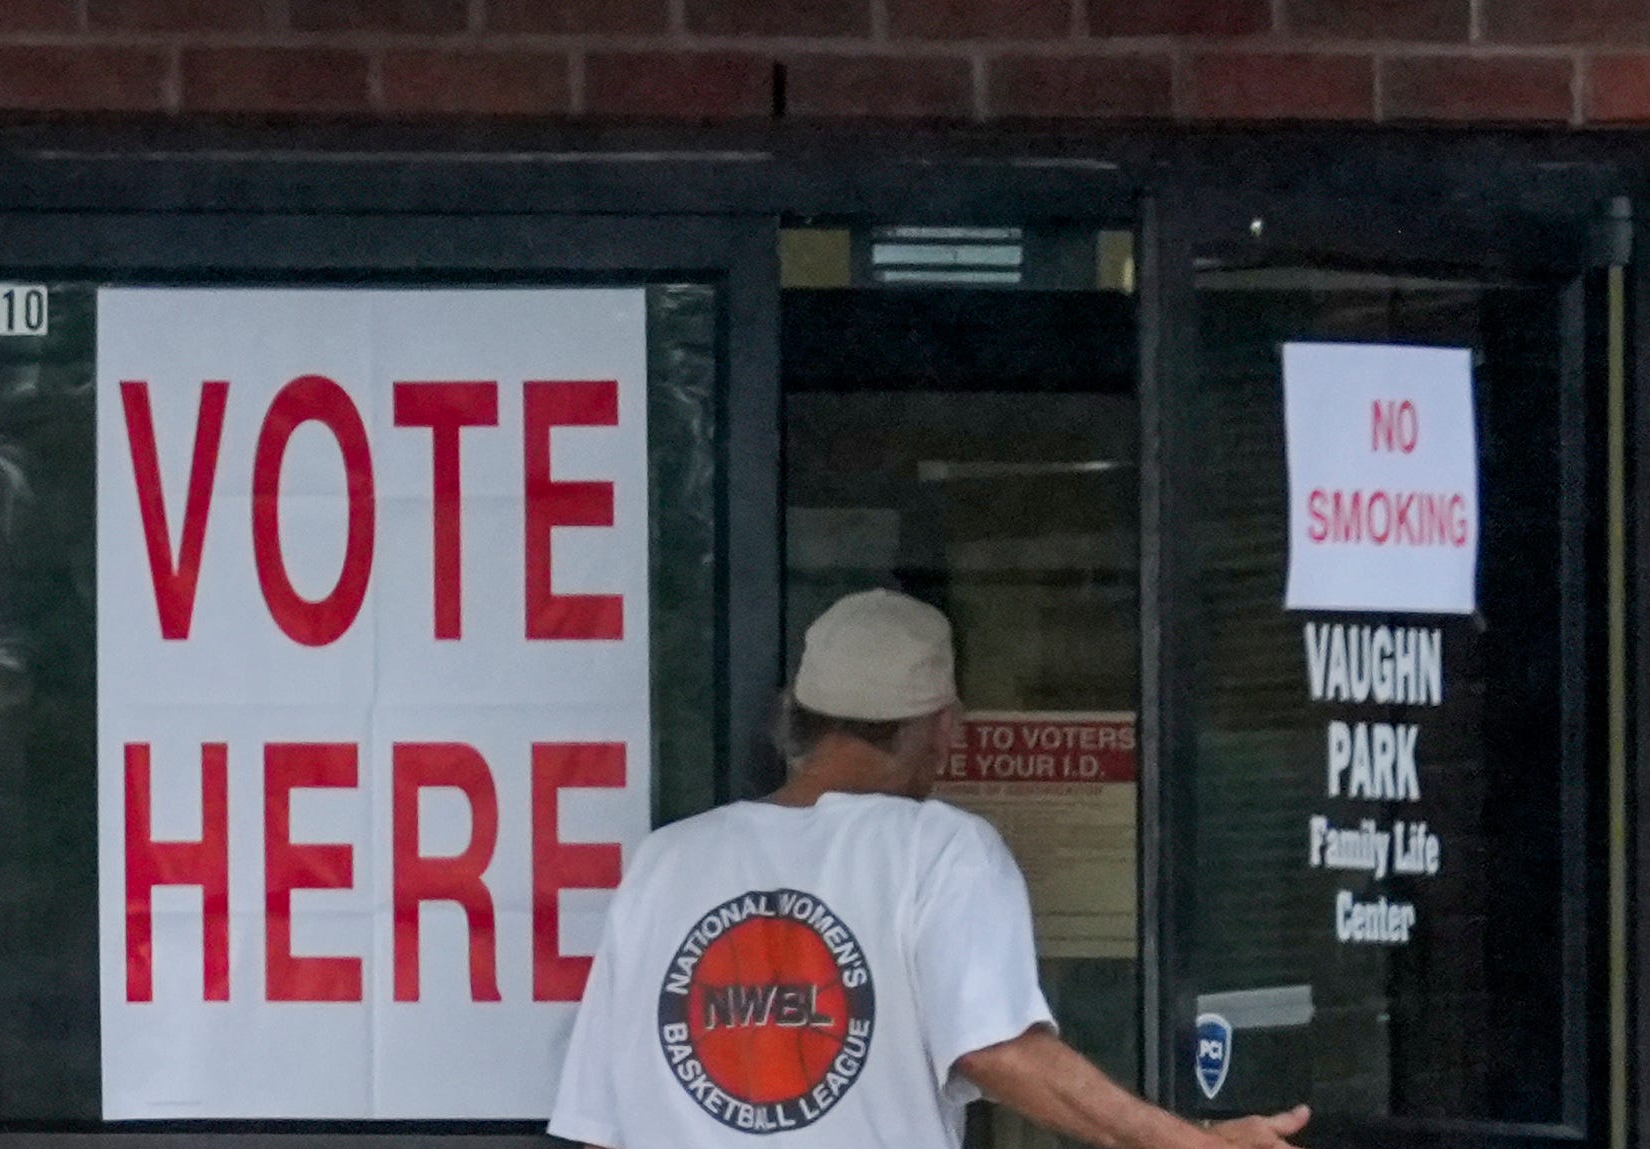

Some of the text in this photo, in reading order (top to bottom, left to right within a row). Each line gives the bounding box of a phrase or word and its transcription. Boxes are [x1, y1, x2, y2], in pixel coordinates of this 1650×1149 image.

[3, 289, 44, 330] 10
[1371, 398, 1419, 454] NO
[119, 373, 625, 647] VOTE
[1308, 487, 1468, 546] SMOKING
[1305, 621, 1442, 706] VAUGHN
[975, 753, 1055, 778] YOUR
[976, 726, 1016, 750] TO
[1021, 726, 1136, 750] VOTERS
[1327, 719, 1421, 802] PARK
[123, 741, 628, 1003] HERE
[1308, 814, 1441, 882] Family Life
[665, 893, 868, 996] NATIONAL WOMEN'S
[1335, 889, 1417, 944] Center
[703, 983, 835, 1030] NWBL
[798, 1017, 871, 1119] LEAGUE
